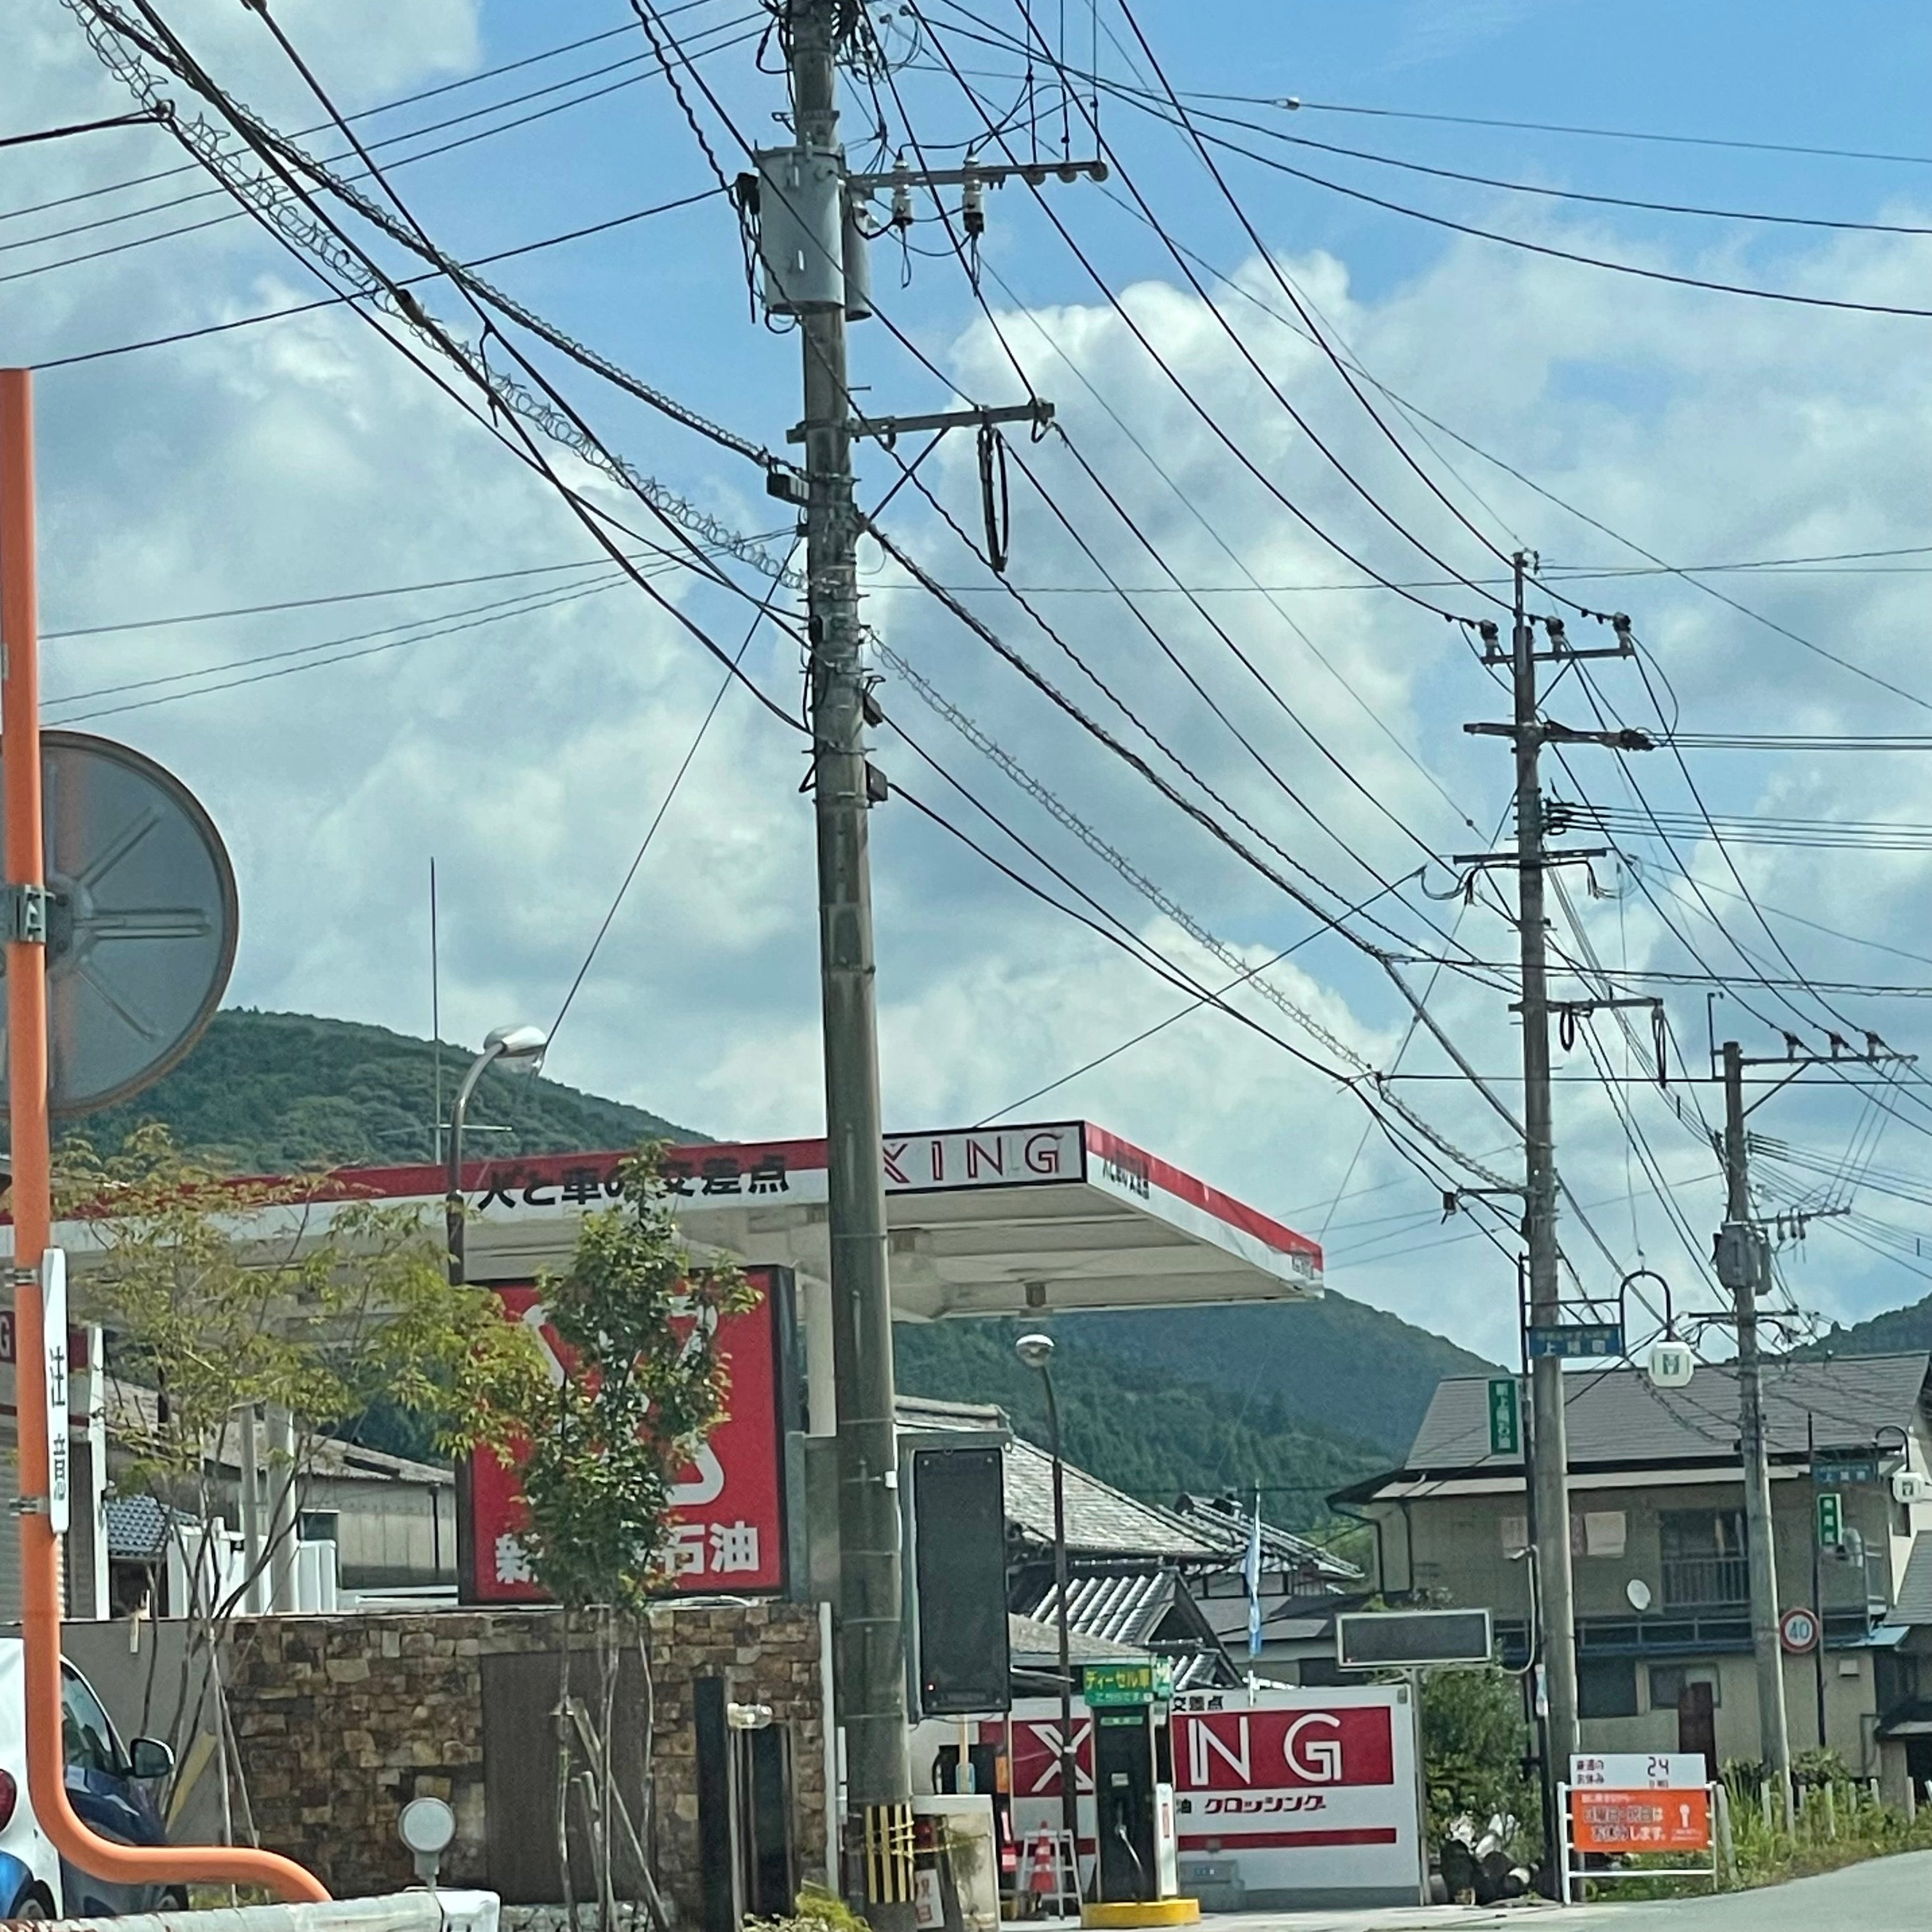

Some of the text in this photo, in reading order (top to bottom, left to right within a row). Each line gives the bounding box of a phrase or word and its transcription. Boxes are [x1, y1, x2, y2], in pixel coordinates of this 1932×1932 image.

[1790, 1621, 1809, 1639] 40
[1028, 1713, 1342, 1792] XNG
[1647, 1756, 1669, 1777] 24
[1204, 1795, 1326, 1814] クロッシング
